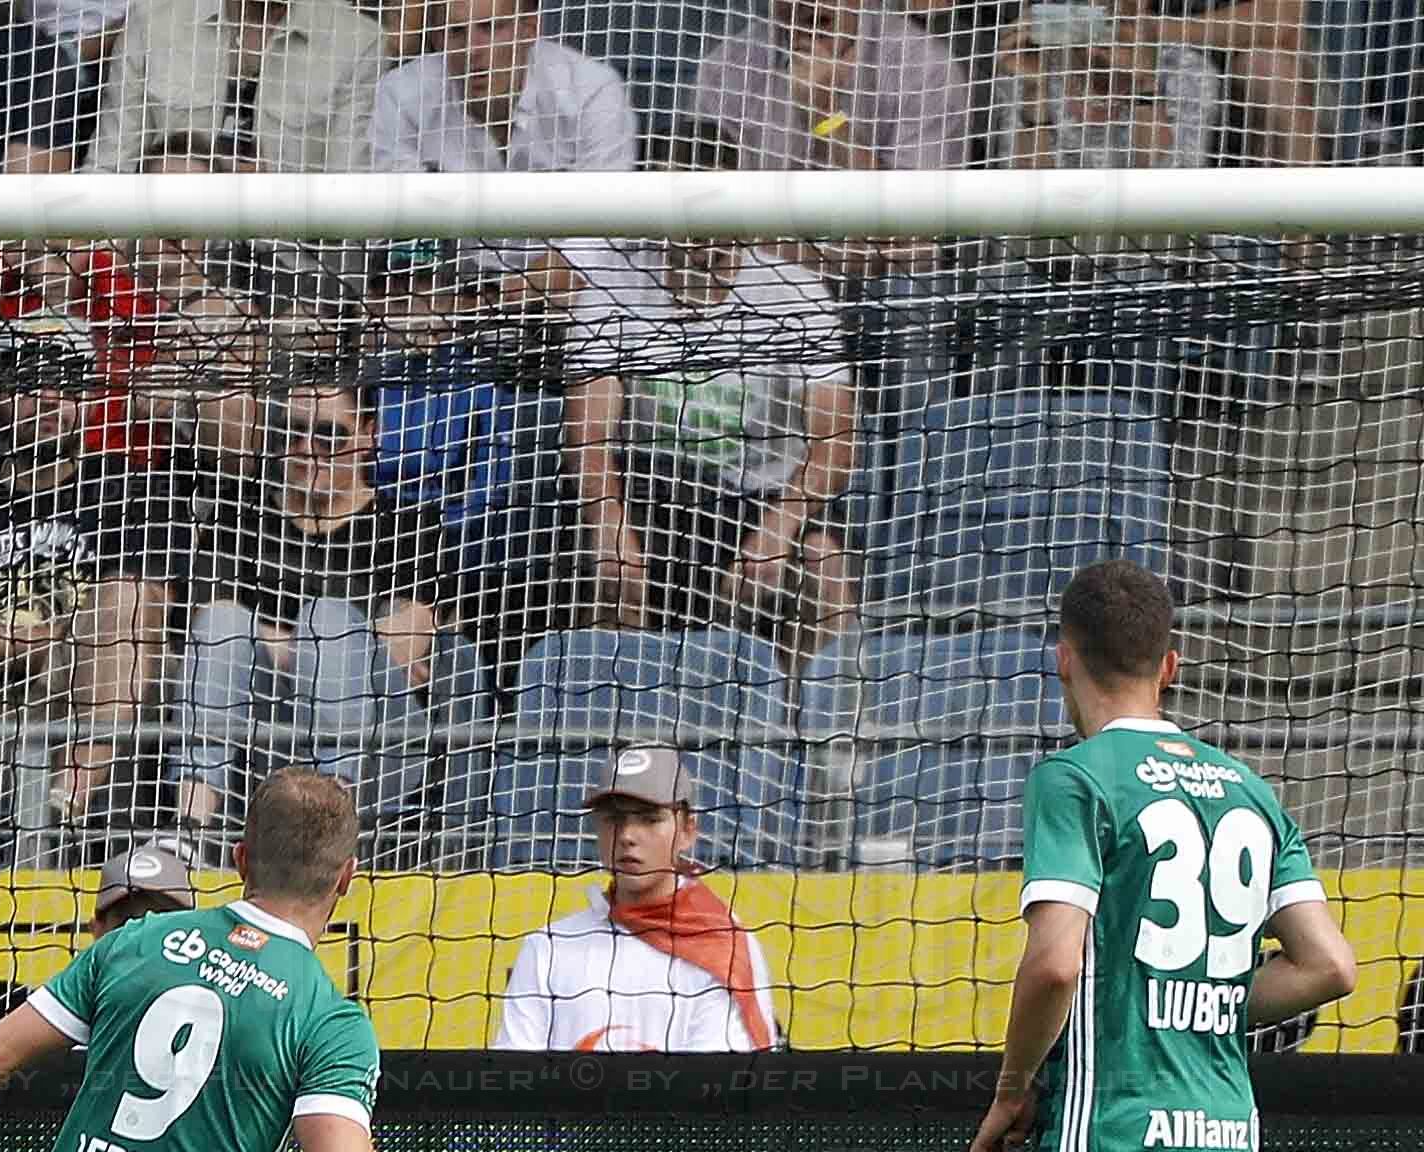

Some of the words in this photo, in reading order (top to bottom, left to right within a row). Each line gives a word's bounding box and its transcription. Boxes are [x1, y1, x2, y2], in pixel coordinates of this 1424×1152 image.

[1134, 798, 1274, 979] 39
[208, 949, 289, 1001] cashback
[111, 985, 226, 1142] 9
[1143, 1109, 1249, 1149] Allianz
